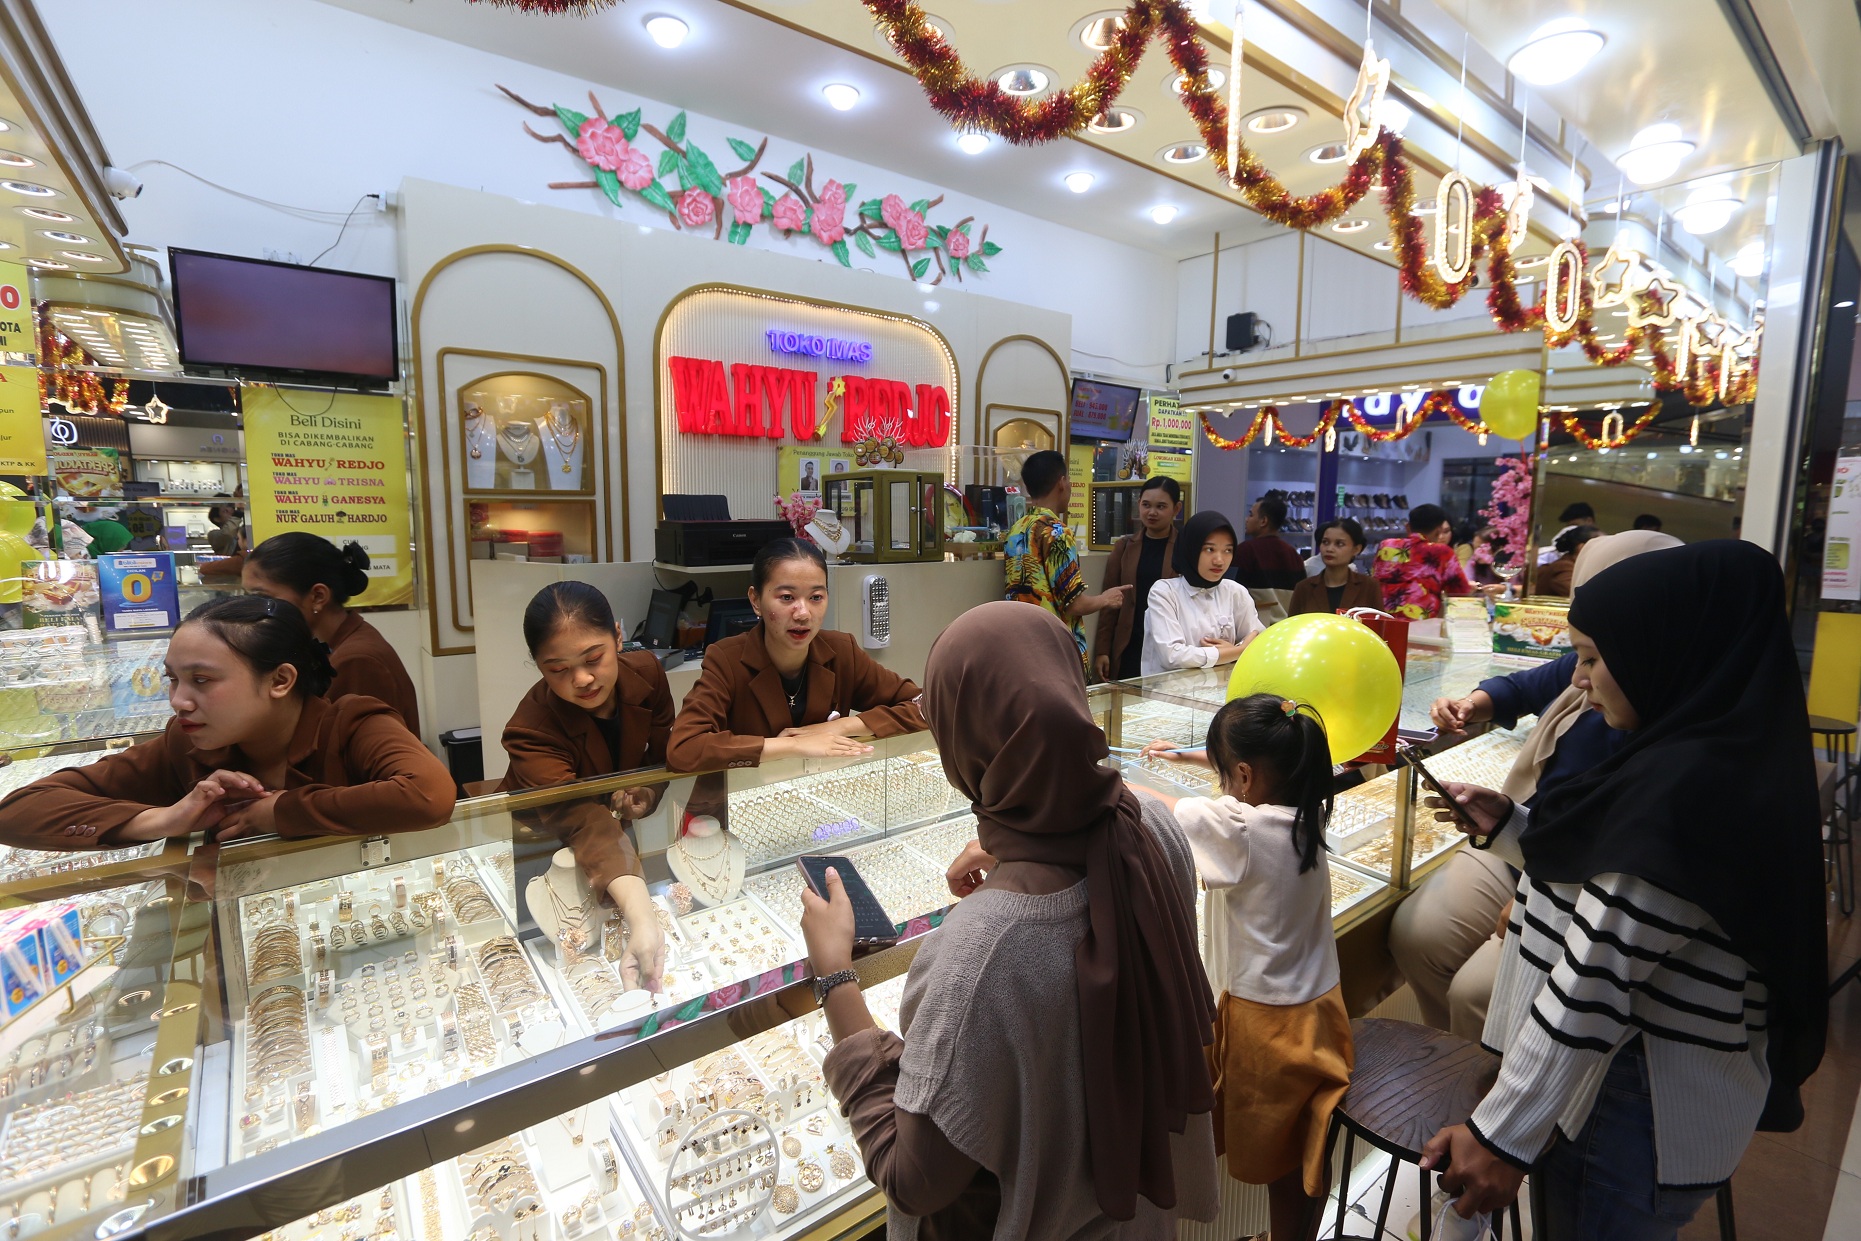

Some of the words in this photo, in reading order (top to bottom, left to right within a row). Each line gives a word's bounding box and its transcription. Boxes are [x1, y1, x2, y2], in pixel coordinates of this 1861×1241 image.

[766, 329, 826, 356] TOKO
[826, 338, 873, 362] MAS
[669, 356, 818, 441] WAHYU
[827, 375, 951, 447] REDJO
[290, 414, 317, 427] Beli
[321, 416, 362, 430] Disini
[303, 433, 375, 442] DIKEMBALIKAN
[293, 440, 374, 450] CABANG-CABANG
[272, 458, 325, 468] WAHYU
[336, 459, 385, 470] REDJO
[273, 476, 320, 485] WAHYU
[338, 478, 385, 487] TRISNA
[274, 495, 319, 504] WAHYU
[331, 496, 386, 505] GANESYA
[301, 514, 335, 523] GALUH
[347, 514, 388, 523] HARDJO
